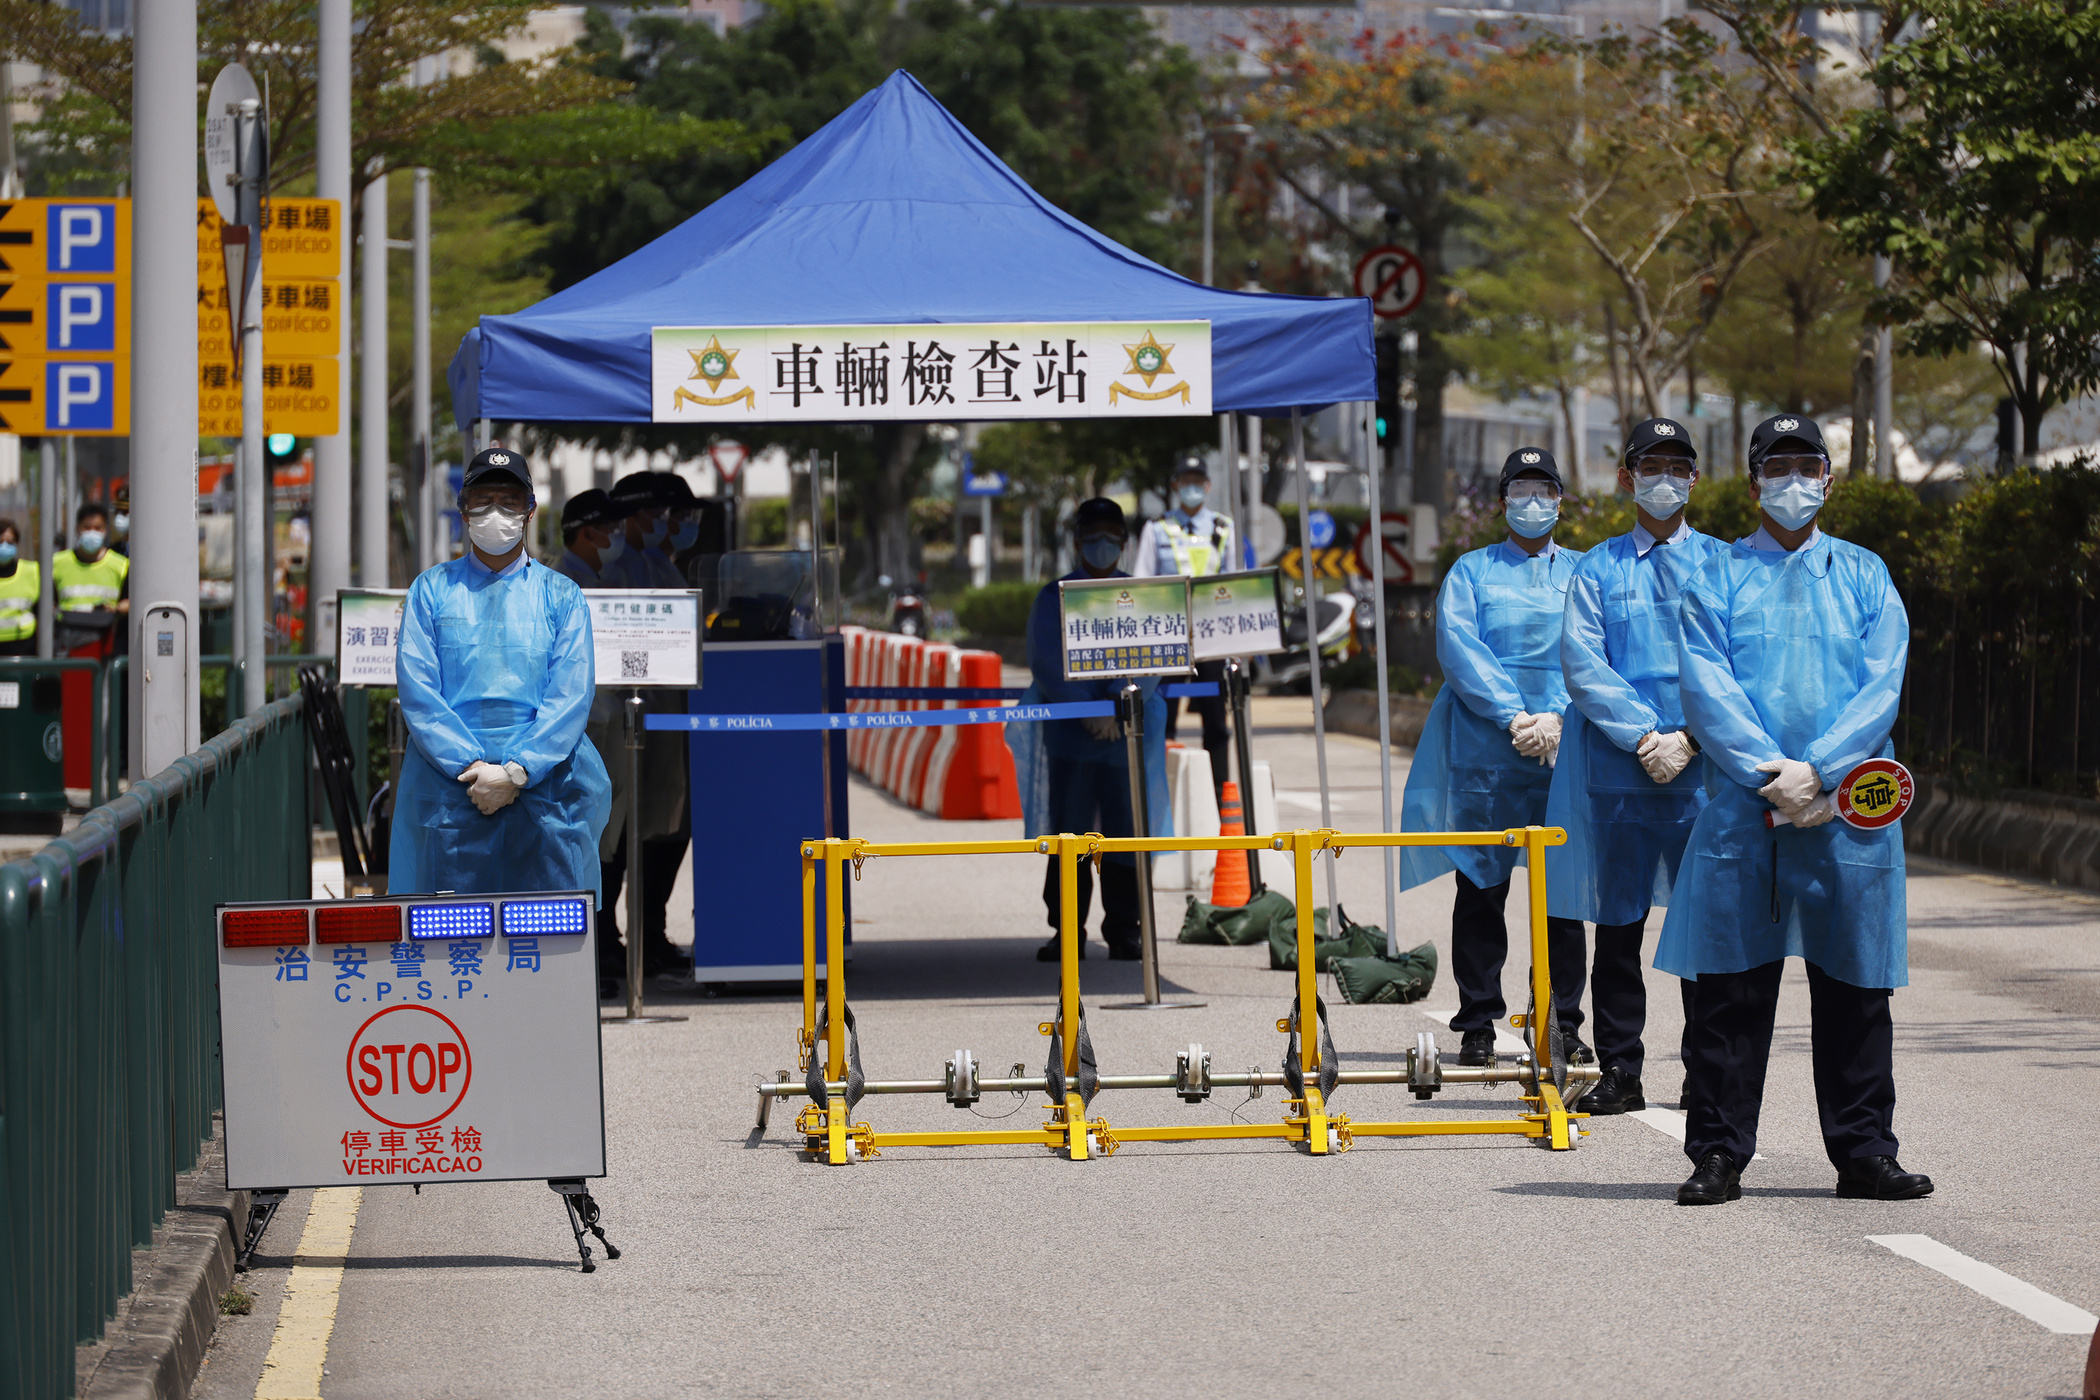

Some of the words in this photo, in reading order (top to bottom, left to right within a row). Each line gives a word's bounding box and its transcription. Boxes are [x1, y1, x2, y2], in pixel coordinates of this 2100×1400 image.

[197, 204, 331, 232] 大車場
[60, 207, 102, 269] P
[59, 286, 102, 347] P
[264, 315, 331, 333] DIFÍCIO
[769, 339, 1089, 407] 車輛檢查站
[58, 365, 101, 426] P
[264, 391, 330, 412] DIFÍCIO
[1068, 613, 1186, 641] 車輛檢查站
[1193, 609, 1279, 638] 客等候區
[727, 716, 773, 728] POLÍCIA
[866, 714, 913, 726] POLÍCIA
[1005, 707, 1051, 720] POLÍCIA
[1854, 776, 1896, 811] 停
[1893, 768, 1911, 807] STOP
[275, 938, 542, 981] 治安警察局
[358, 1042, 462, 1096] STOP
[340, 1125, 483, 1158] 停車受檢
[342, 1156, 483, 1176] VERIFICACAO
